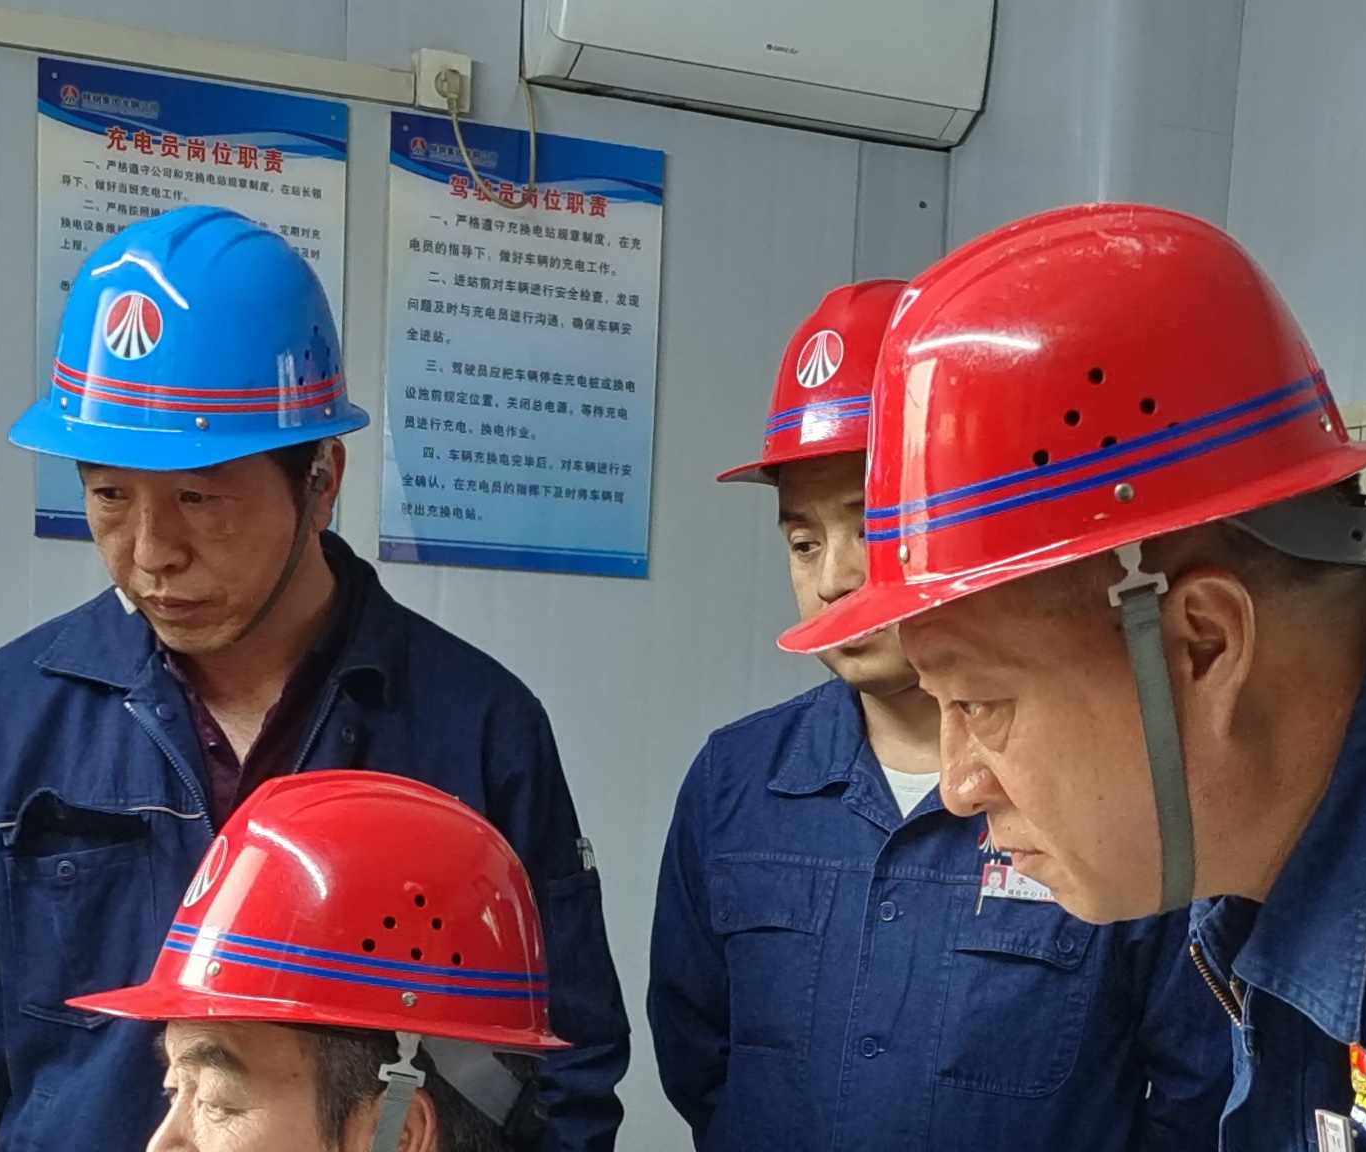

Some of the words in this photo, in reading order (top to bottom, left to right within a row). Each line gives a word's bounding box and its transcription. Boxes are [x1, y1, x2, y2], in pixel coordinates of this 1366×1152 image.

[104, 123, 285, 176] 充电员岗位职责
